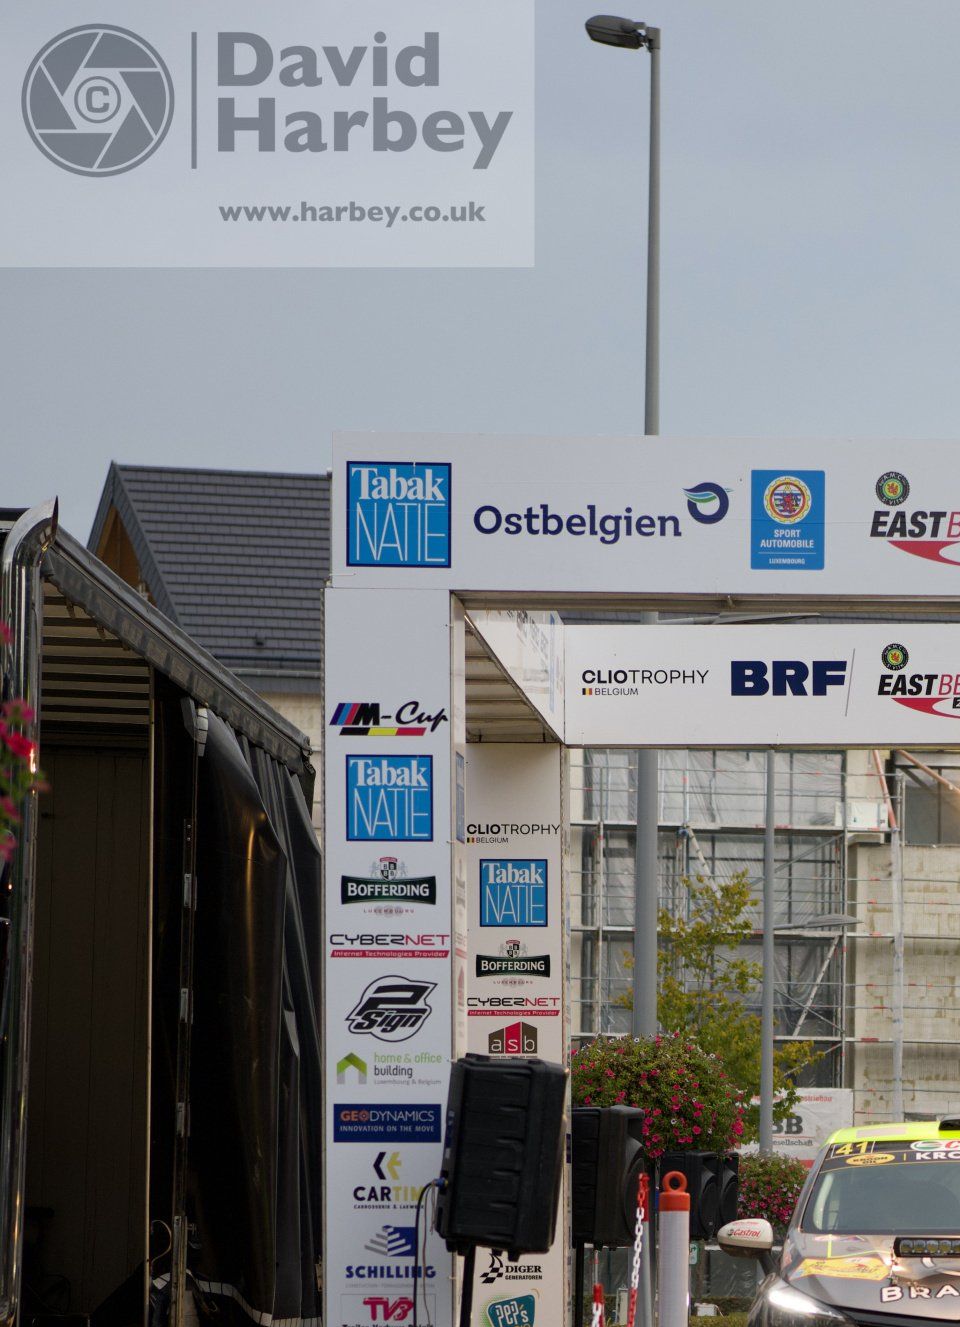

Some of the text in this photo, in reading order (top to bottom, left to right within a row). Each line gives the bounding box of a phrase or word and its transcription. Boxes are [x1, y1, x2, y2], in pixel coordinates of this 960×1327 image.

[351, 467, 444, 500] Tabak
[473, 504, 682, 545] Ostbelgien
[355, 502, 446, 562] NATIE
[774, 529, 801, 538] SPORT
[760, 539, 814, 548] AUTOMOBILE
[582, 669, 709, 684] CLIOTROPHY
[731, 661, 847, 696] BRF
[594, 687, 638, 695] BELGIUM
[350, 760, 428, 787] Tabak
[354, 788, 429, 837] NATIE
[467, 824, 560, 835] CLIOTROPHY
[482, 862, 544, 884] Tabak
[348, 883, 429, 897] BOFFERDING
[486, 885, 544, 923] NATIE
[329, 934, 450, 946] CYBERNET
[481, 960, 545, 972] BOFFERDING
[467, 997, 560, 1007] CYBERNET
[490, 1033, 536, 1053] asb
[374, 1052, 442, 1063] home office
[374, 1064, 413, 1078] building
[340, 1110, 434, 1122] GEODYNAMICS
[836, 1142, 868, 1155] 41
[505, 1265, 542, 1273] DIGER
